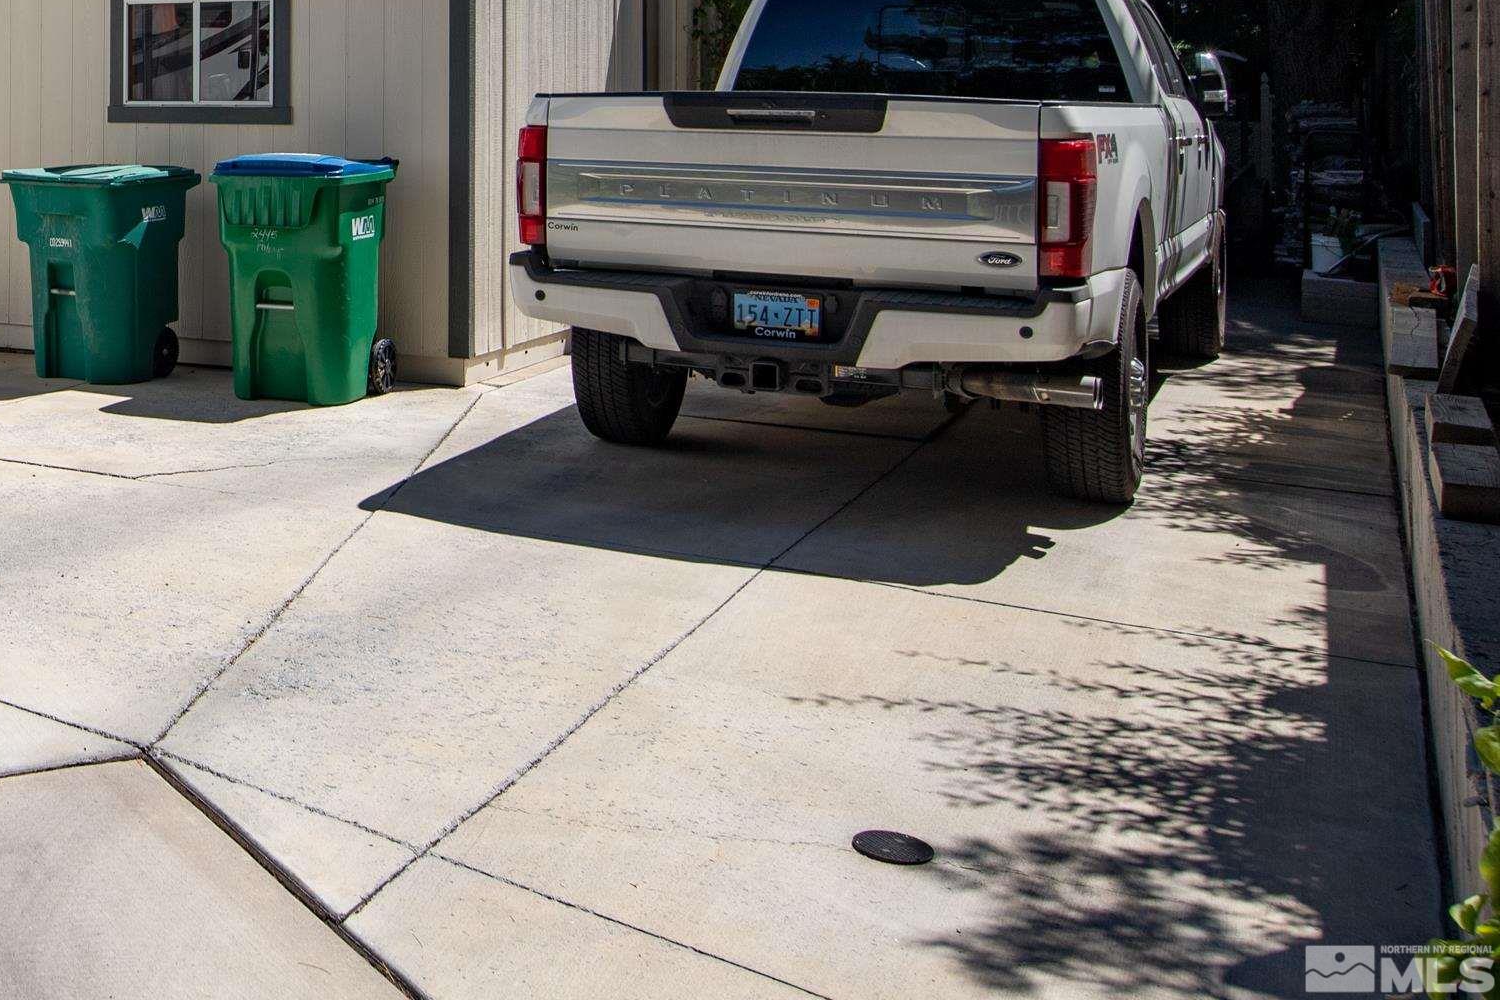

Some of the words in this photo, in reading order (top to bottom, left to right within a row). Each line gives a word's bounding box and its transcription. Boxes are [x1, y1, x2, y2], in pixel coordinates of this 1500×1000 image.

[619, 183, 943, 211] PLATINUM
[351, 215, 376, 237] WM
[547, 221, 579, 231] Corwin
[756, 295, 799, 304] NEVADA
[737, 303, 768, 325] 154
[784, 307, 817, 329] ZTT
[755, 327, 796, 339] Corwin
